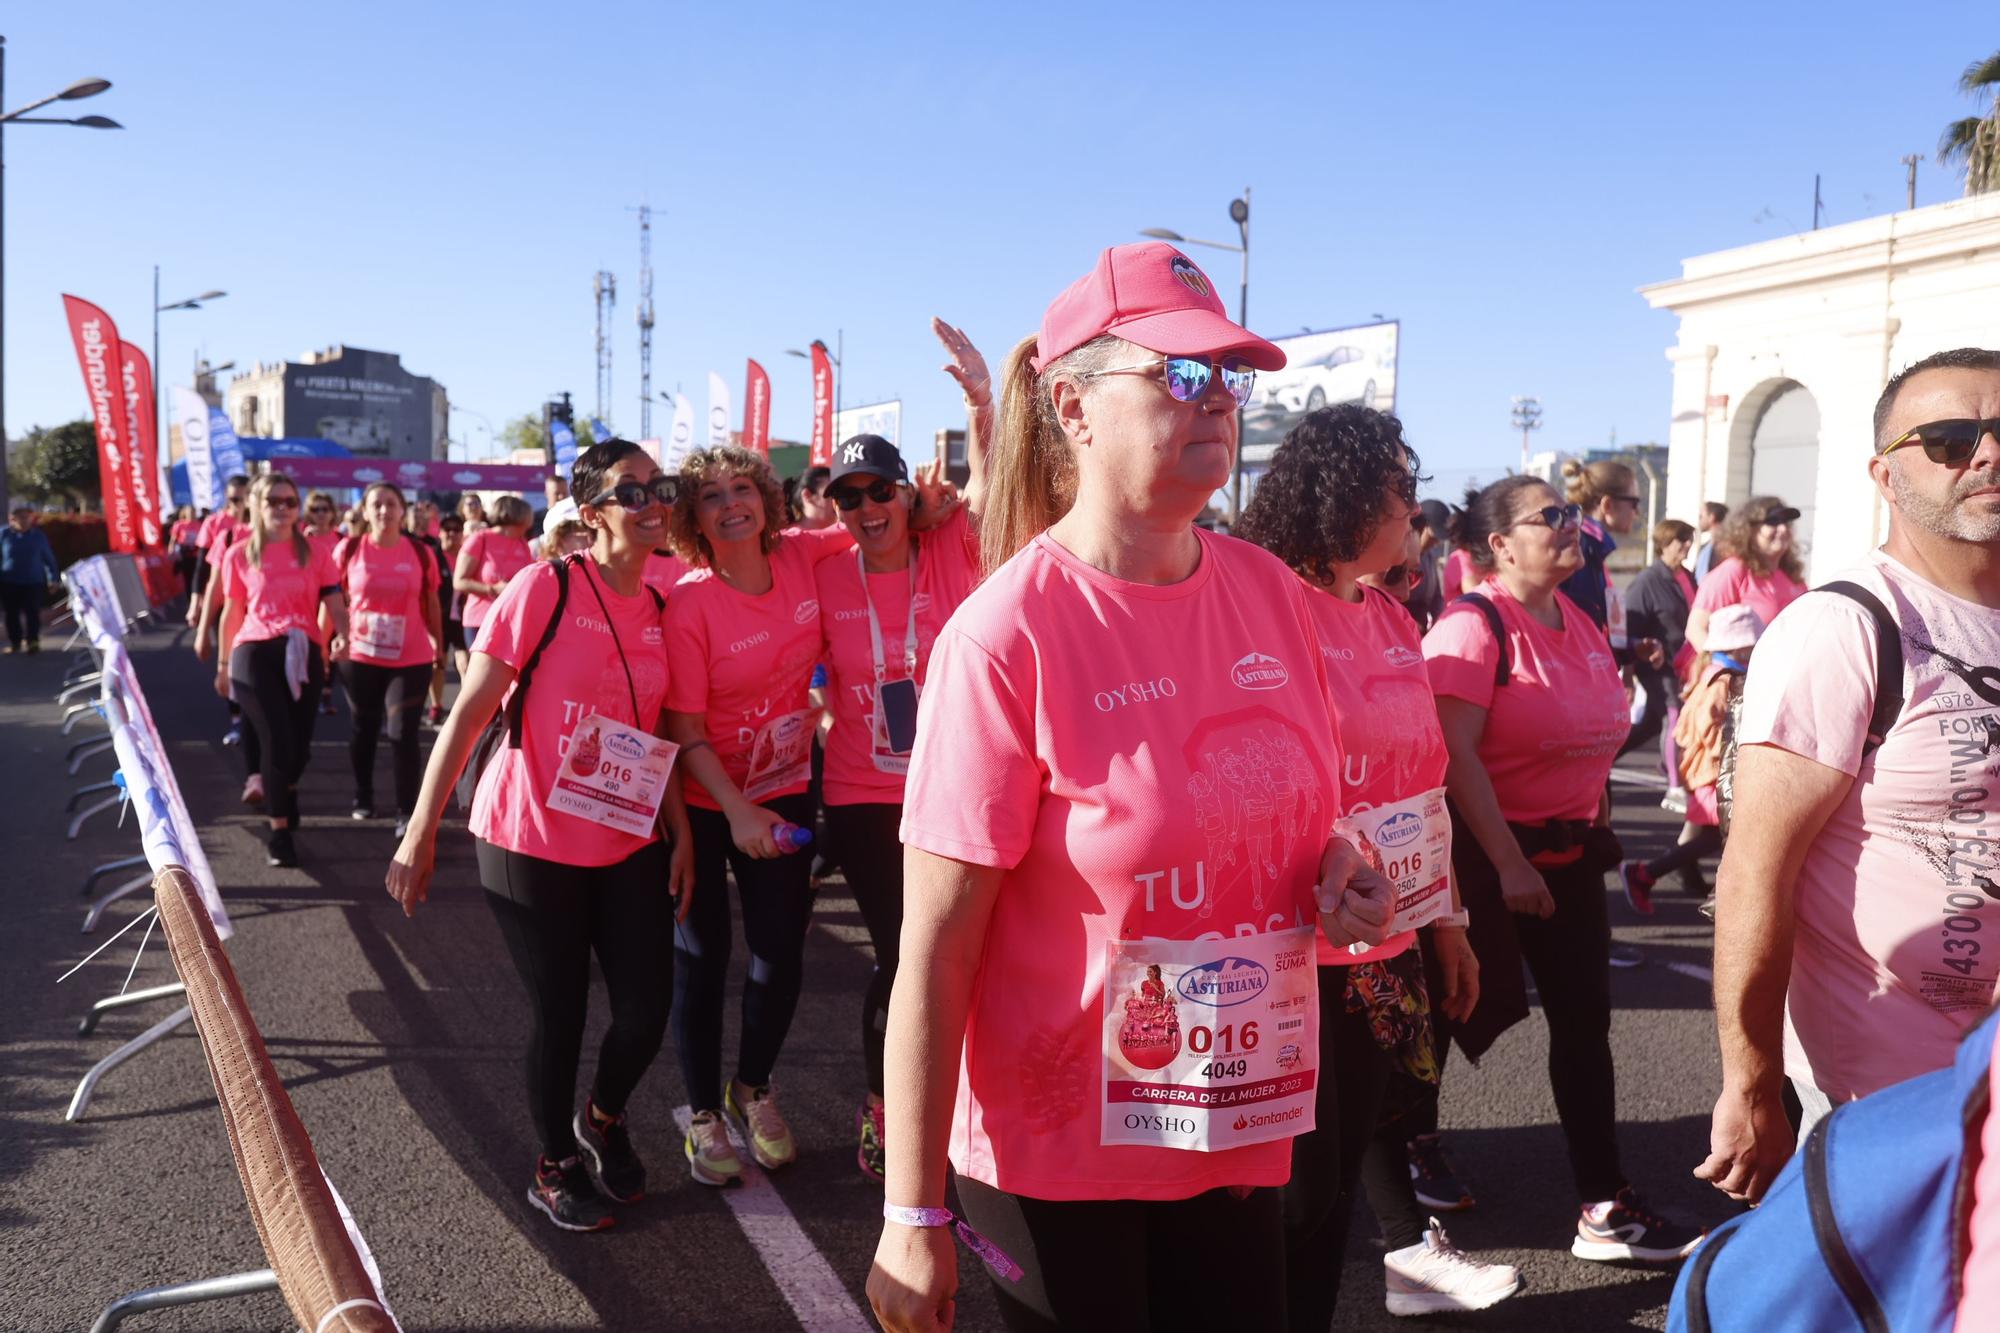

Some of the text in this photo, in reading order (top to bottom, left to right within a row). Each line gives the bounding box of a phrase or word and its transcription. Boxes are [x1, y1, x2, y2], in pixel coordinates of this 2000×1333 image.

[730, 631, 769, 653] OYSHO
[1094, 676, 1176, 711] OYSHO
[1934, 693, 1974, 709] 1978
[601, 761, 632, 782] 016
[1344, 754, 1367, 786] U
[604, 780, 619, 792] 490
[560, 795, 592, 812] OYSHO
[1381, 822, 1420, 843] ASTURIANA
[1389, 852, 1422, 880] 016
[1135, 862, 1205, 911] TU
[1274, 956, 1307, 972] SUMA
[1185, 976, 1263, 995] ASTURIANA
[1188, 1021, 1259, 1053] 016
[1201, 1060, 1246, 1080] 4049
[1132, 1087, 1195, 1102] CARRERA
[1200, 1094, 1217, 1103] DE
[1221, 1093, 1236, 1103] LA
[1239, 1086, 1275, 1101] MUJER
[1124, 1114, 1196, 1134] OYSHO
[1249, 1105, 1303, 1128] Santander
